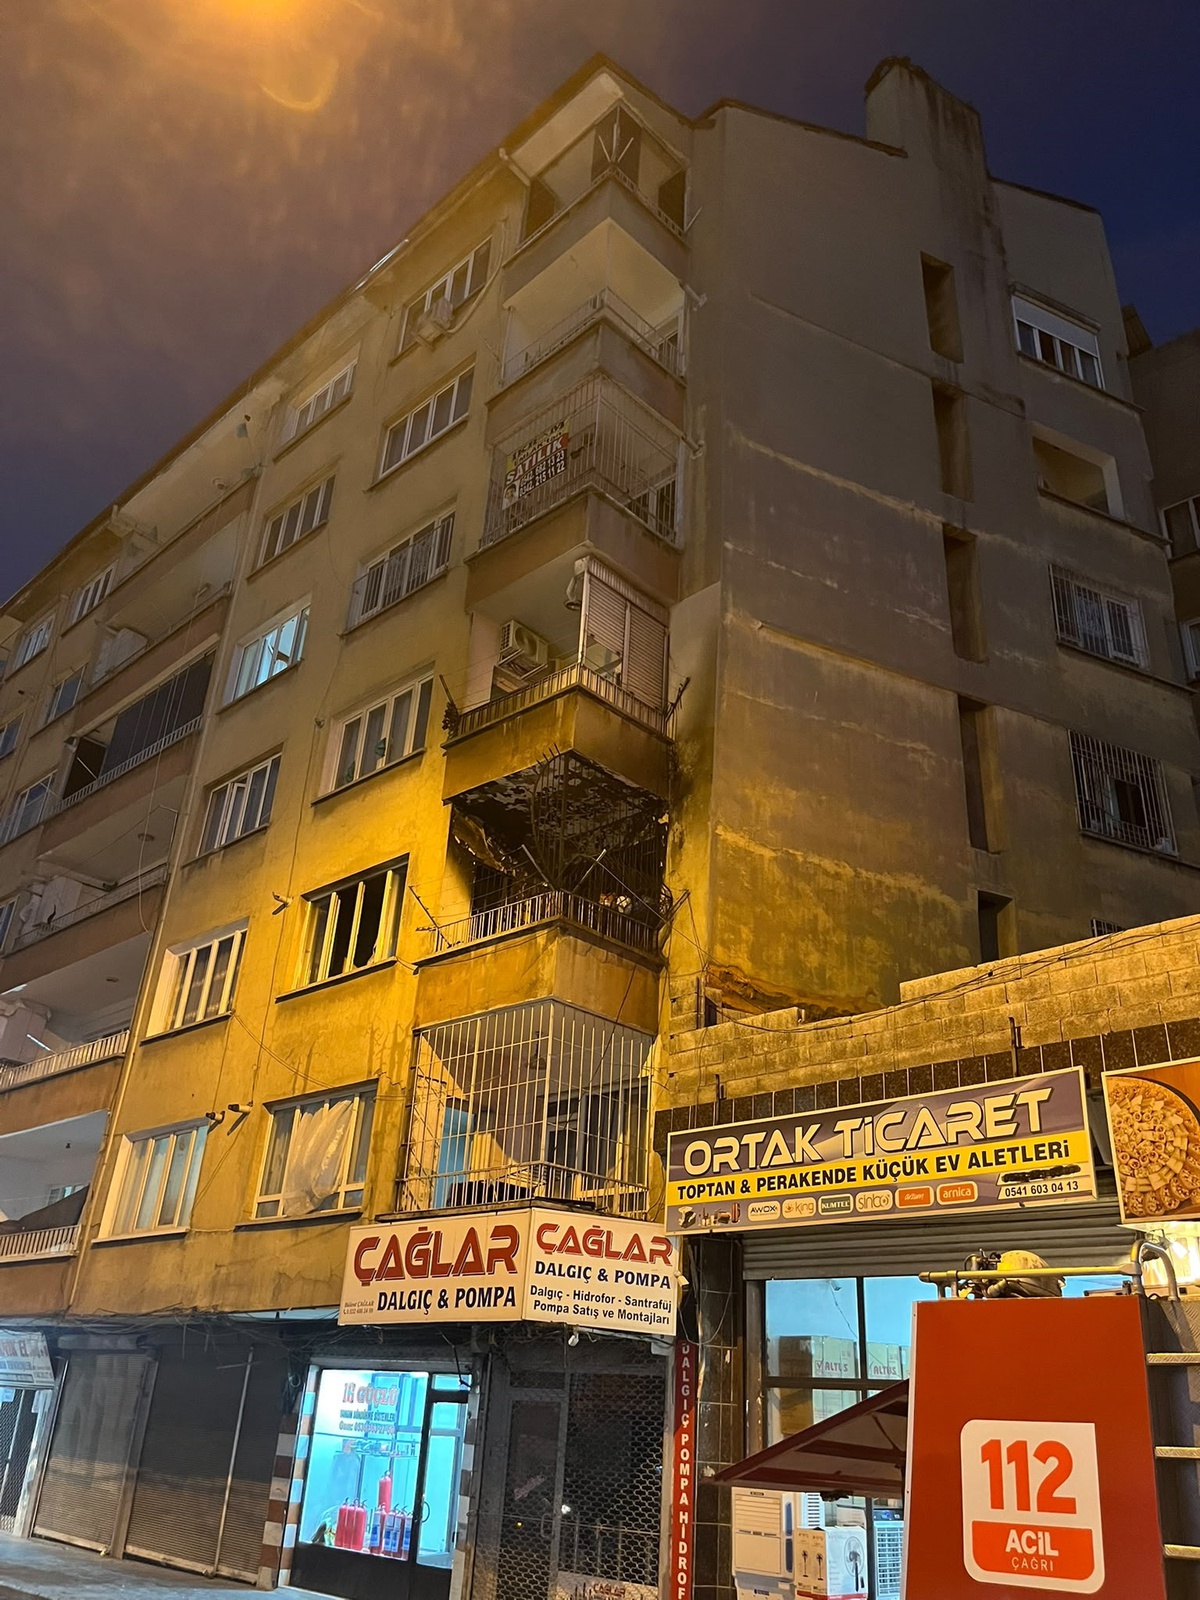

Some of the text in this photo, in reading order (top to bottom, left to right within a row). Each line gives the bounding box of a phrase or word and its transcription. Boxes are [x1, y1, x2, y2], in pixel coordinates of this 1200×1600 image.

[506, 436, 563, 485] SATILIK
[684, 1123, 821, 1175] ORTAK
[678, 1180, 735, 1201] TOPTAN
[740, 1178, 751, 1194] &
[756, 1169, 856, 1192] PERAKENDE
[862, 1157, 929, 1182] KÜÇÜK
[935, 1154, 959, 1172] EV
[1005, 1181, 1078, 1197] 0541 603 04 13
[795, 1200, 814, 1215] king
[821, 1200, 849, 1210] KUMTEL
[942, 1188, 971, 1198] arnica
[353, 1223, 519, 1286] ÇAĞLAR
[536, 1222, 674, 1266] ÇAĞLAR
[534, 1260, 671, 1289] DALGIÇ & POMPA
[377, 1286, 516, 1314] DALGIÇ & POMPA
[530, 1285, 563, 1301] Dalgıç
[573, 1289, 615, 1305] Hidrofor
[624, 1295, 672, 1314] Santrafüj
[533, 1300, 670, 1325] Pompa Satış ve Montajları
[873, 1366, 897, 1375] ALTUS
[681, 1342, 690, 1429] DALGIÇ
[679, 1433, 690, 1505] POMPA
[981, 1439, 1077, 1515] 112
[1005, 1529, 1059, 1557] ACİL
[1011, 1557, 1054, 1572] ÇAĞRI
